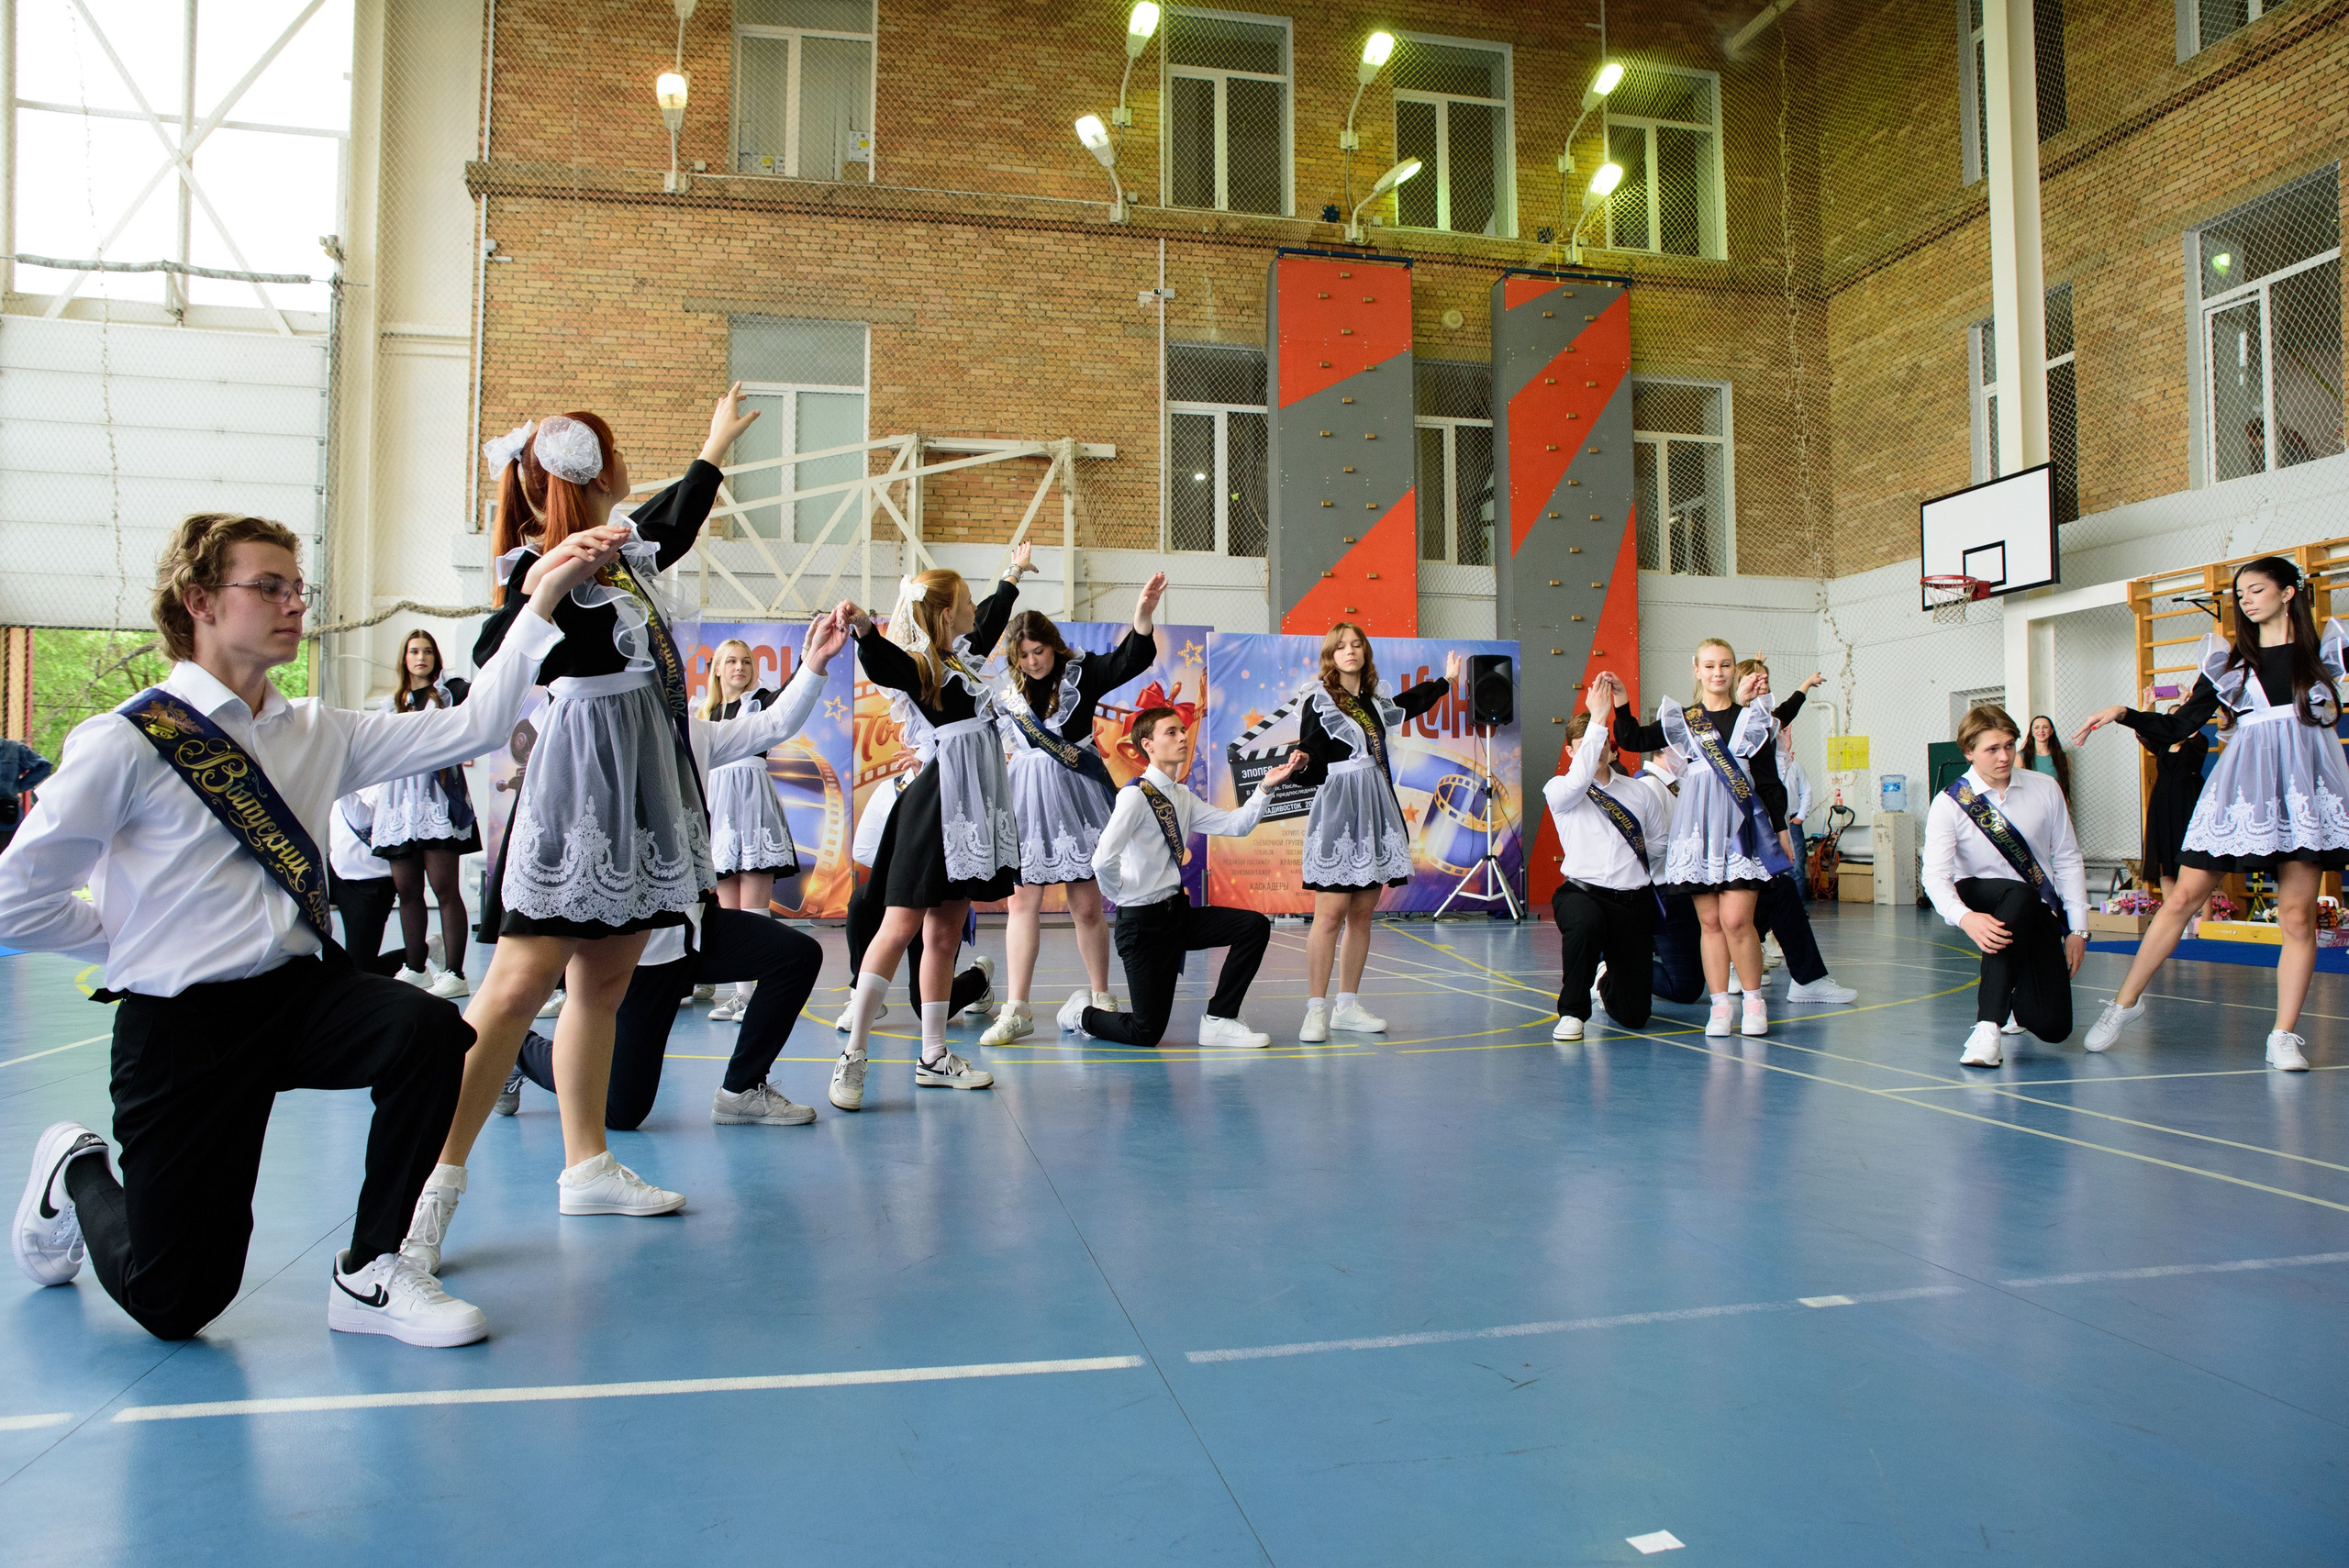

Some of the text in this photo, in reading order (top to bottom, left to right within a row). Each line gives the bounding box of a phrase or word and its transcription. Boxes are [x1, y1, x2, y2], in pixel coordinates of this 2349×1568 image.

[1008, 697, 1063, 754] Выпускница
[1059, 743, 1082, 763] 2026
[1400, 665, 1497, 740] КИН
[1689, 717, 1753, 799] Выпускница 2026
[174, 738, 312, 894] Выпускник
[1969, 804, 2044, 885] Выпускник 2026
[1250, 882, 1290, 891] КАСКАДЕРЫ
